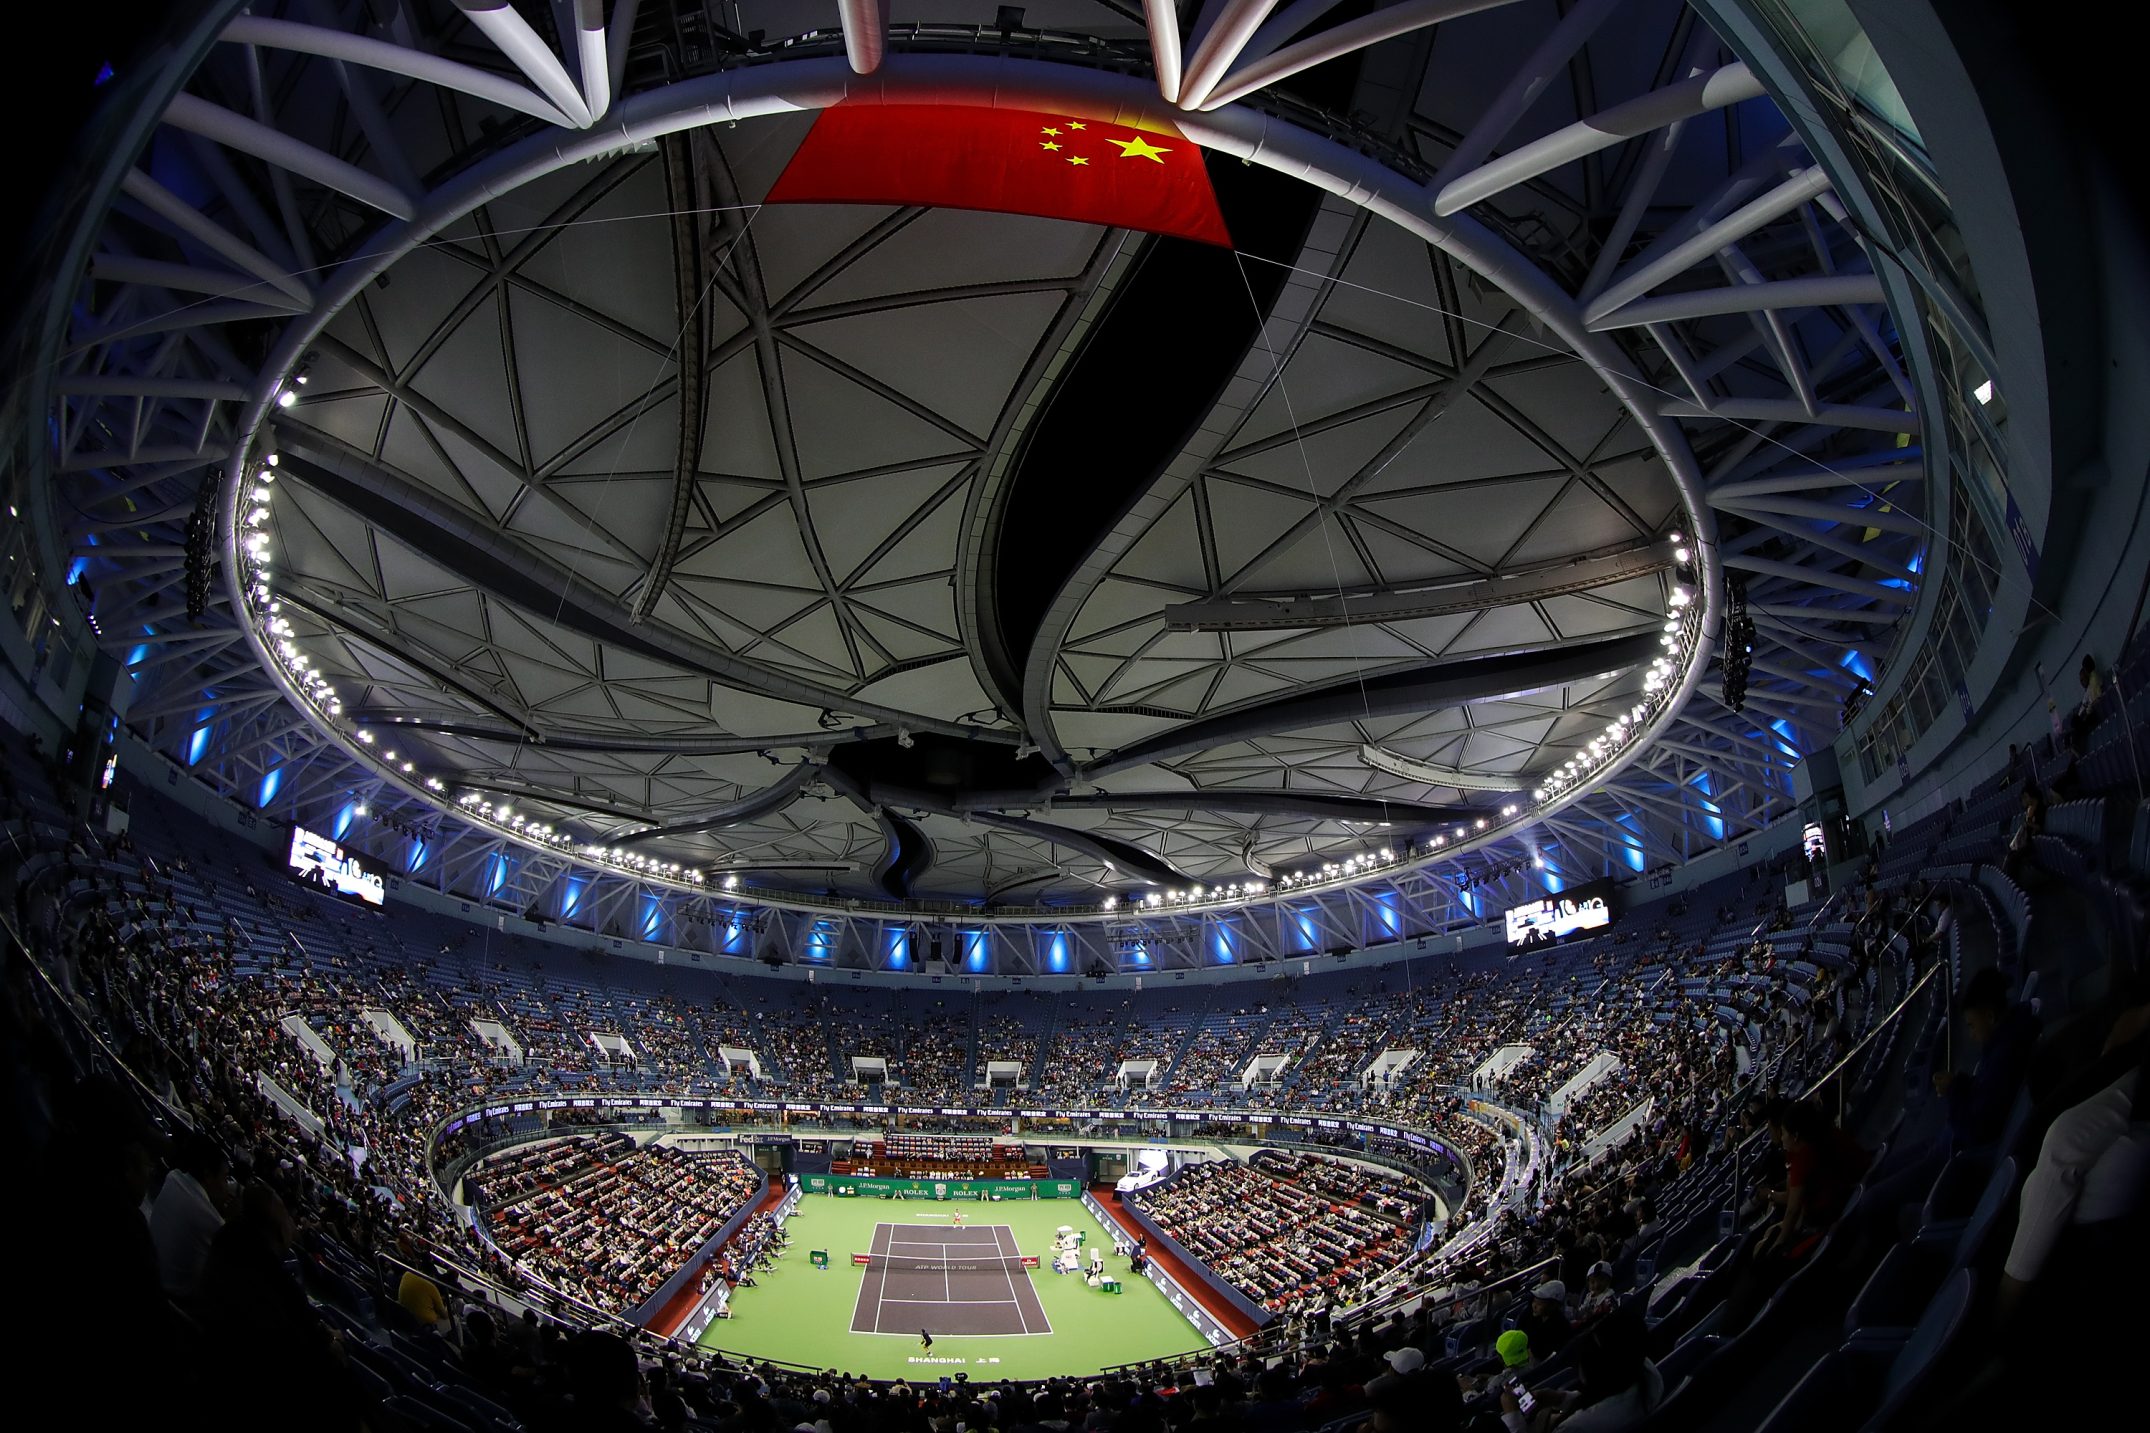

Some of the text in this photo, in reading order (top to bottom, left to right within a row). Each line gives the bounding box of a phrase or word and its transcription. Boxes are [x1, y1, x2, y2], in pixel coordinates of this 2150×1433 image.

[602, 1099, 610, 1107] Fly
[671, 1100, 680, 1108] Fly
[1208, 1114, 1218, 1122] Fly
[1280, 1116, 1290, 1125] Fly
[1346, 1122, 1374, 1132] Fly Emirates
[1187, 1313, 1201, 1330] LACOSTE
